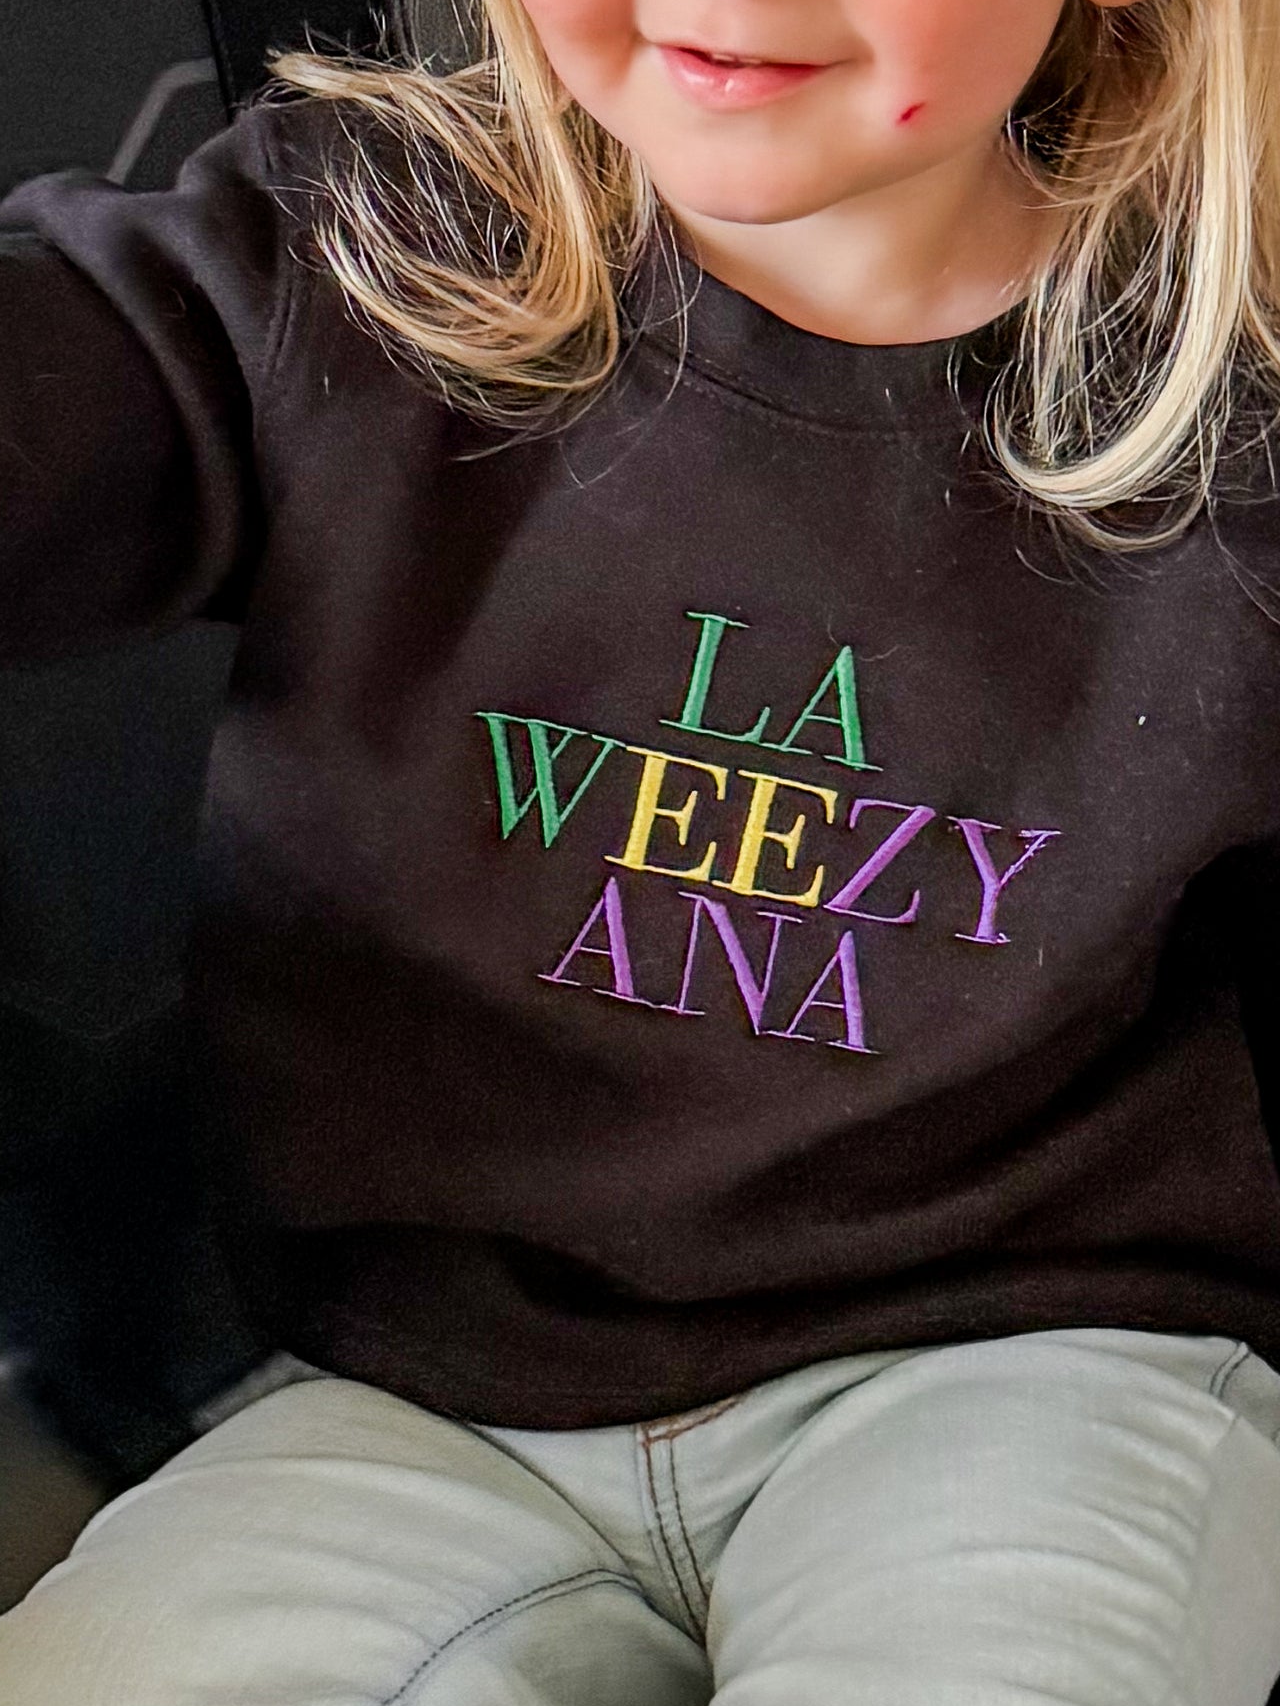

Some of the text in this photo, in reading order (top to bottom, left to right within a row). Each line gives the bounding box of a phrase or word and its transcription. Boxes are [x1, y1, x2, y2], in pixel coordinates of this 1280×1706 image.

[659, 610, 884, 772] LA
[473, 710, 1062, 945] WEEZY
[536, 876, 882, 1055] ANA
